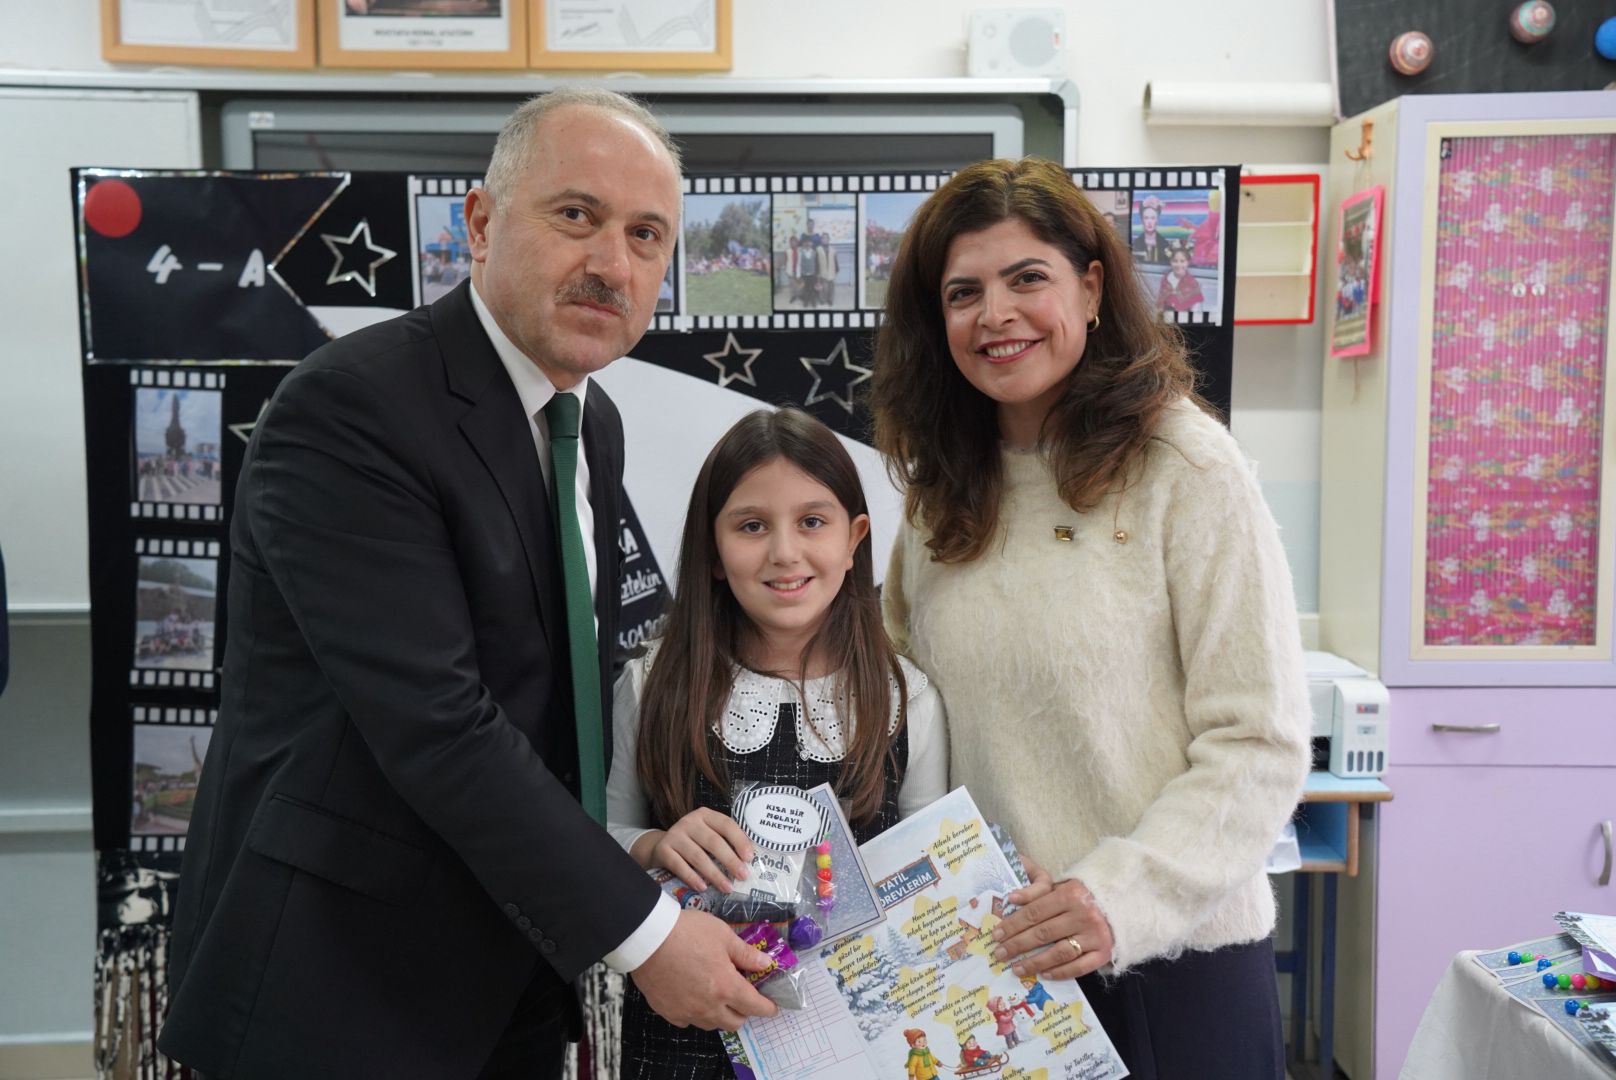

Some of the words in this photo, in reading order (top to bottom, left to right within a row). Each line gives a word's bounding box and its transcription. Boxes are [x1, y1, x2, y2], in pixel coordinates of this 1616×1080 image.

[621, 569, 662, 600] ztekin
[766, 804, 787, 814] KISA
[789, 807, 805, 818] BİR
[766, 812, 800, 825] MOLAYI
[759, 819, 802, 834] HAKETTİK
[952, 823, 974, 838] beraber
[938, 851, 946, 859] bir
[880, 872, 909, 892] TATİL
[879, 872, 932, 908] ÖREVLERİM
[838, 948, 852, 964] güzel
